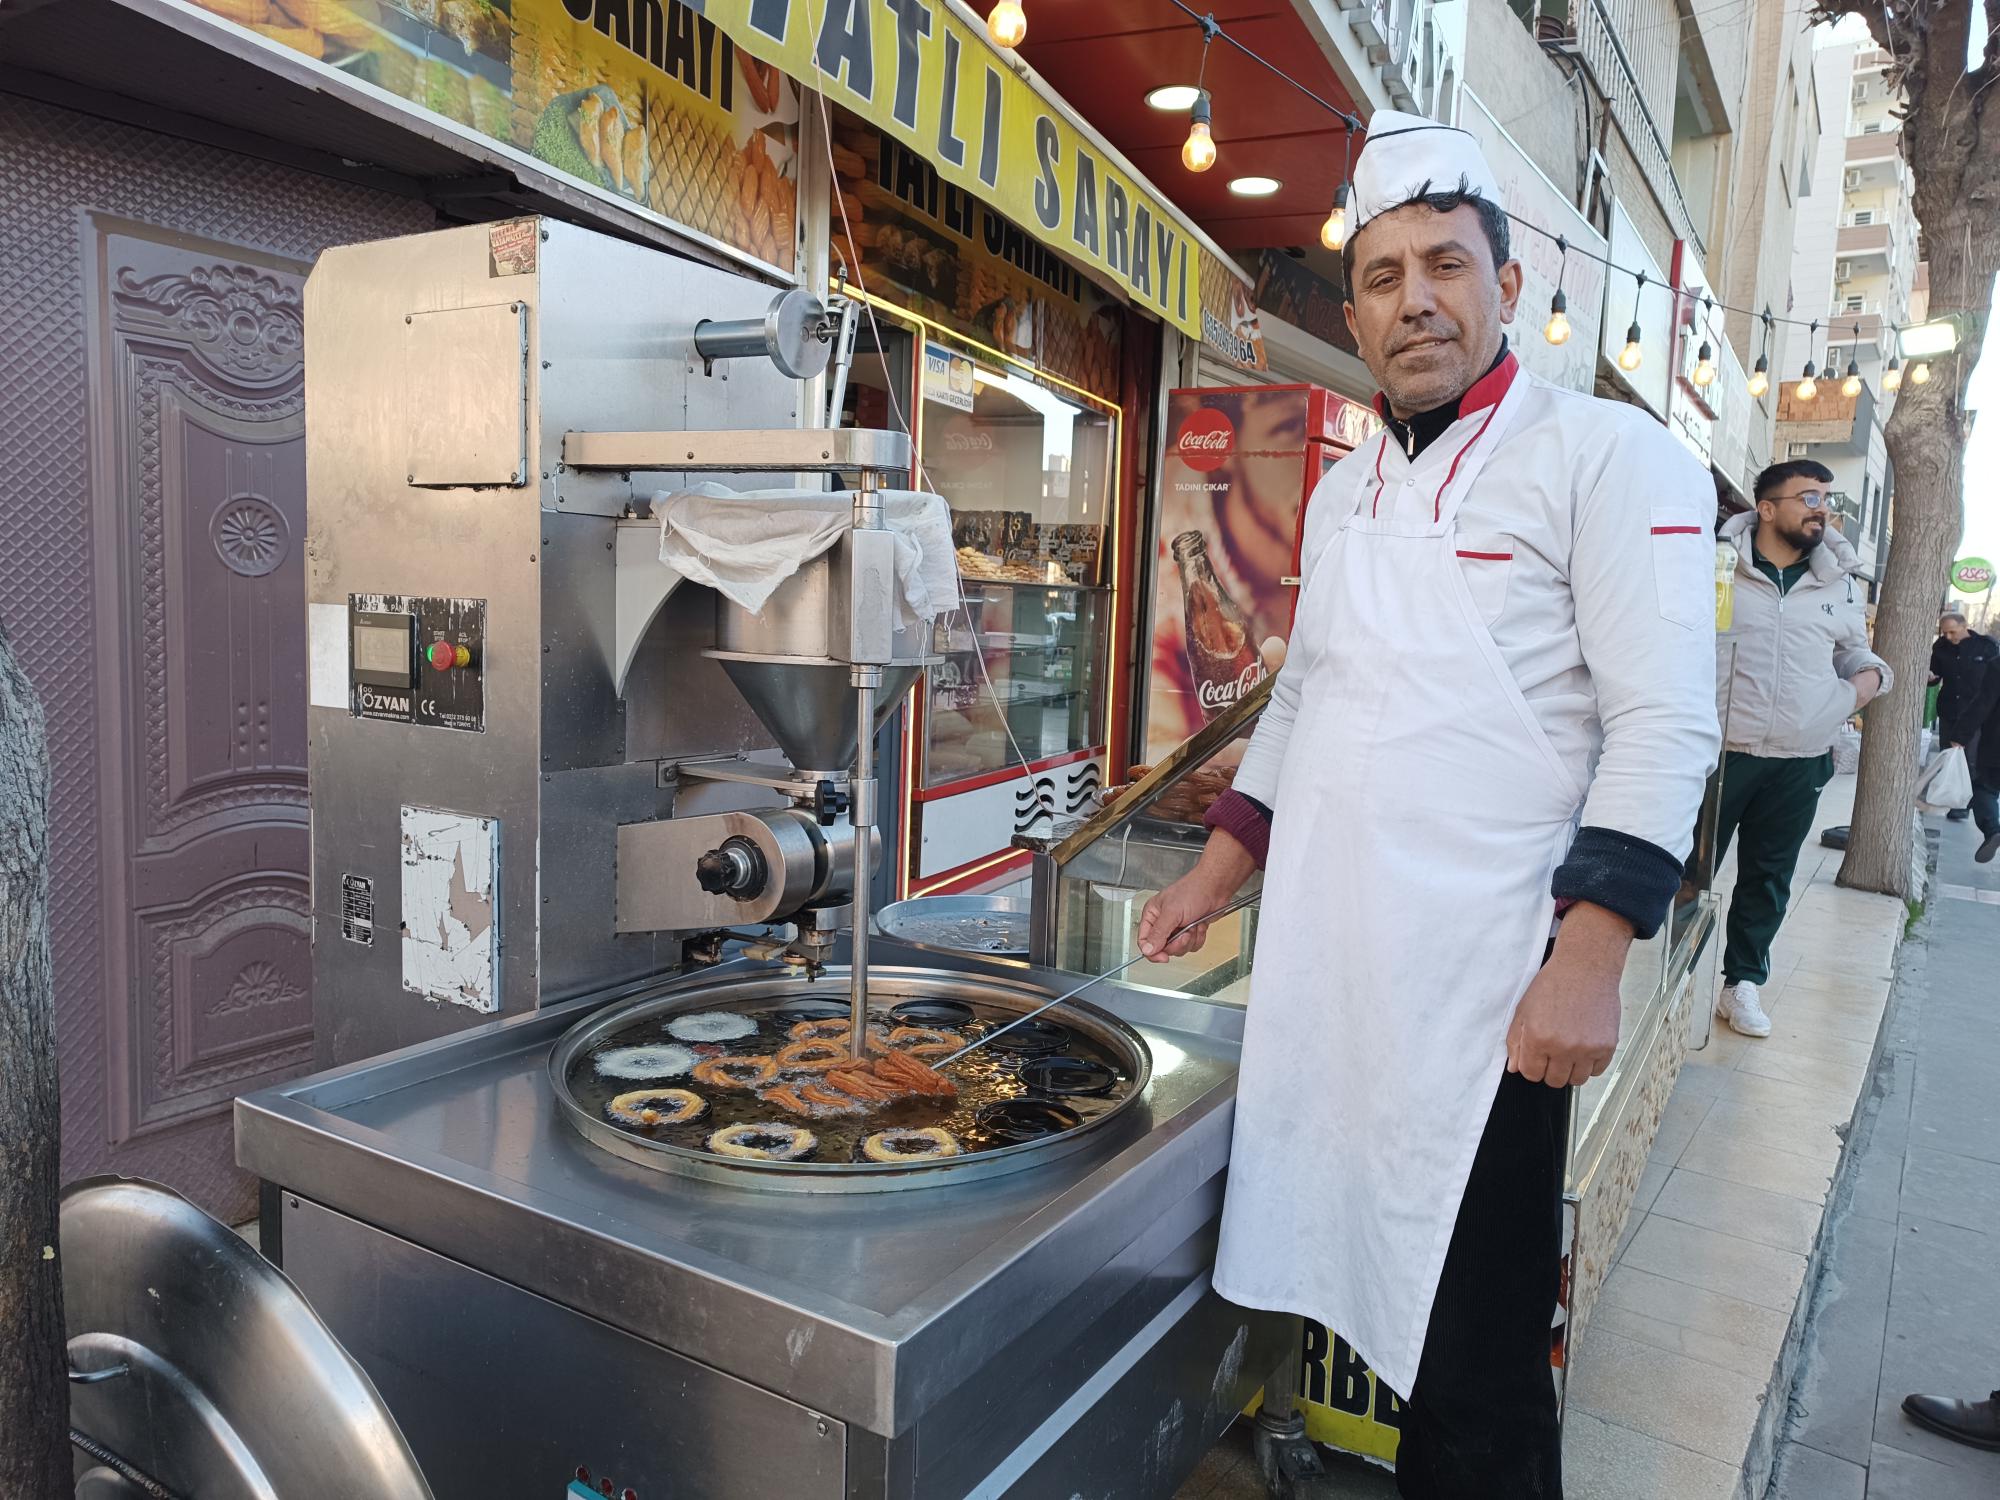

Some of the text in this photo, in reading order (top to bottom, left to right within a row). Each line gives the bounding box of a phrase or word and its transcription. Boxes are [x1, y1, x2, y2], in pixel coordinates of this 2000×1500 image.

[747, 0, 1188, 325] ATLI SARAYI
[1240, 338, 1257, 365] 64
[928, 356, 945, 376] VISA
[1180, 430, 1232, 450] Coca-Cola
[1175, 483, 1201, 492] TADINI
[362, 686, 410, 713] ÖZVAN
